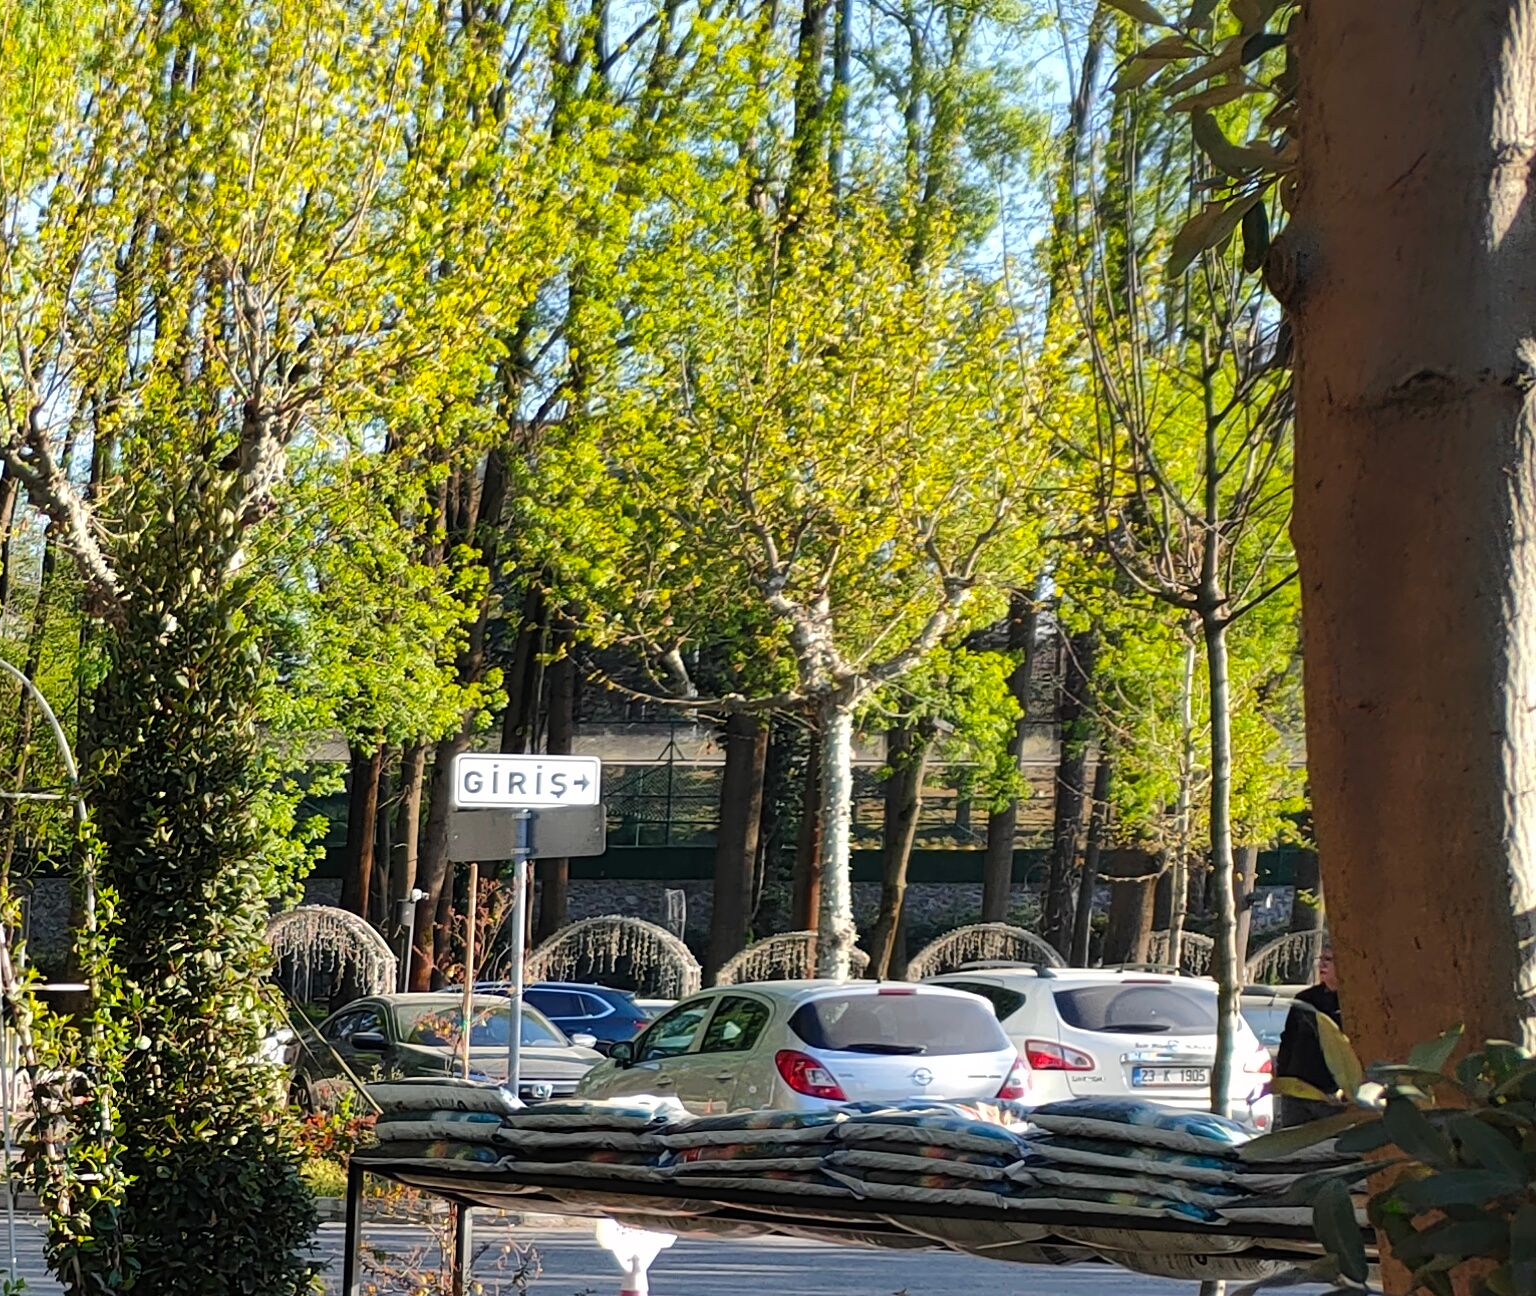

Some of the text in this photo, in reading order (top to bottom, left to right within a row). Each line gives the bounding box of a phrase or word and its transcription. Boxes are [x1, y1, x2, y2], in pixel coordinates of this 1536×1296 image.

[463, 764, 568, 799] GİRİŞ
[1141, 1069, 1206, 1082] 23 K 1905
